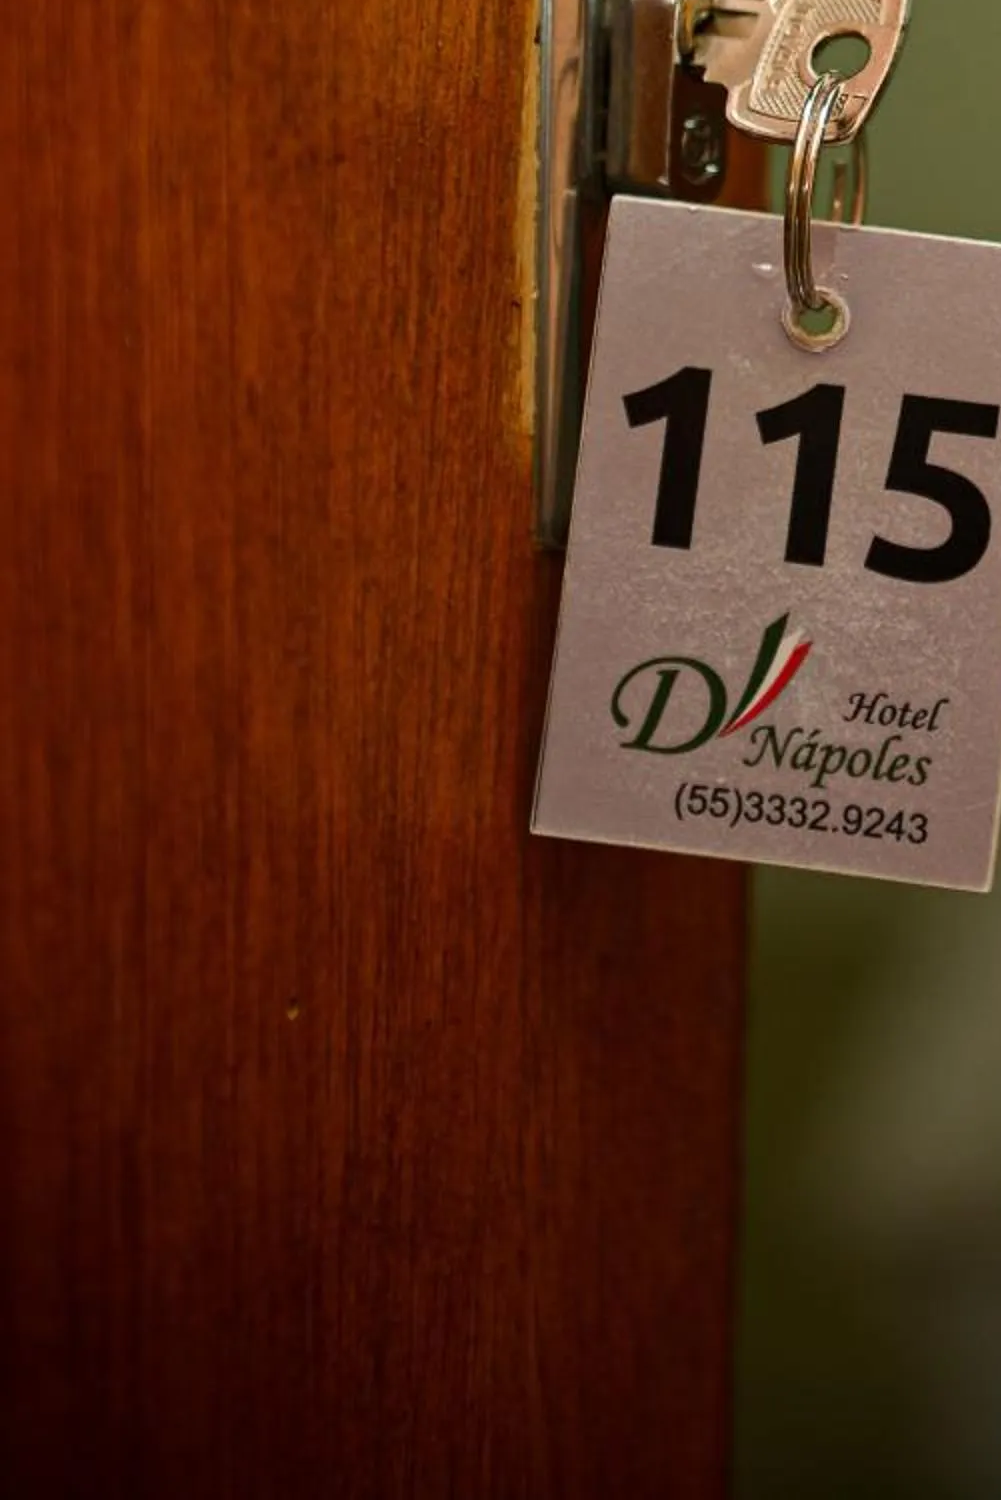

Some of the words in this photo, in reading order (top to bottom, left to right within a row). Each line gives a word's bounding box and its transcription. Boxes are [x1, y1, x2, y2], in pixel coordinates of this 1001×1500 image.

[622, 365, 1001, 584] 115
[842, 692, 949, 732] Hotel
[742, 724, 933, 789] Nápoles
[675, 782, 929, 845] (55)3332.9243
